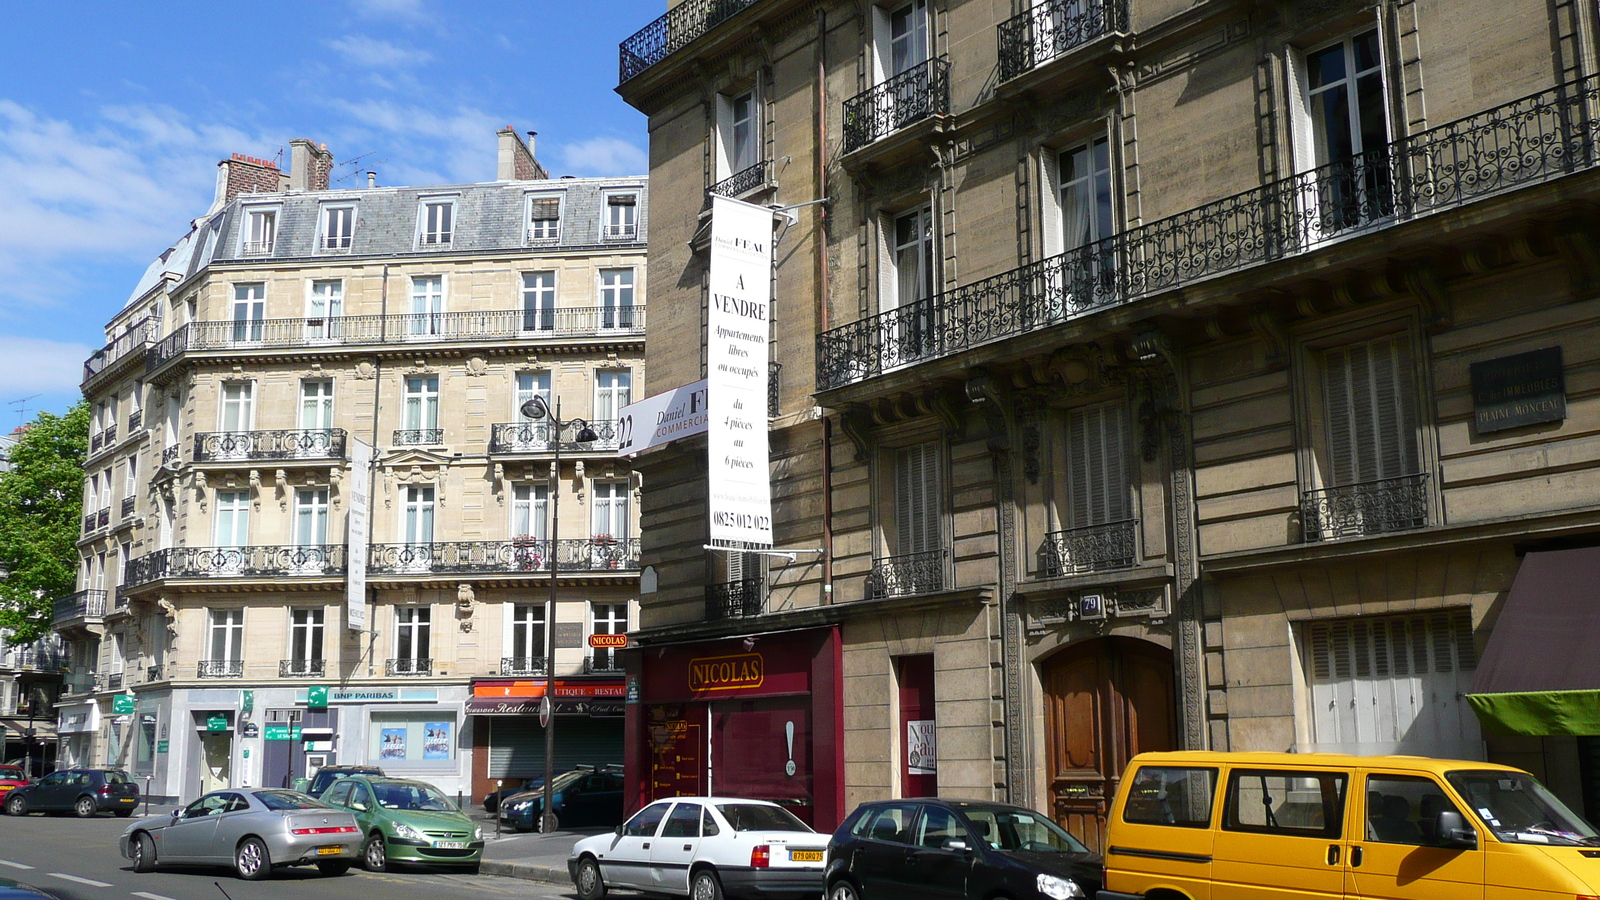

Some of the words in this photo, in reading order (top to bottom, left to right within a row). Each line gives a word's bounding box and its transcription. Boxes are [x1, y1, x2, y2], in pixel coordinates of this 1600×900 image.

[735, 237, 768, 255] FEAU
[735, 274, 745, 290] A
[714, 293, 766, 321] VENDRE
[714, 325, 765, 344] Appartements
[728, 344, 749, 358] libres
[718, 363, 728, 372] ou
[729, 367, 759, 379] occupés
[1503, 378, 1559, 398] IMMEUBLES
[733, 398, 743, 410] du
[1515, 399, 1560, 418] MONCEAU
[656, 402, 686, 426] Daniel
[724, 416, 729, 427] 4
[730, 418, 753, 430] pièces
[733, 439, 744, 448] au
[724, 455, 730, 466] 6
[730, 457, 754, 469] pièces
[713, 510, 735, 527] 0825
[736, 513, 752, 529] 012
[754, 515, 769, 531] 022
[1084, 597, 1096, 610] 79
[592, 637, 625, 645] NICOLAS
[693, 660, 759, 685] NICOLAS
[909, 724, 934, 744] Nou
[793, 852, 804, 860] 879
[816, 852, 823, 860] 75
